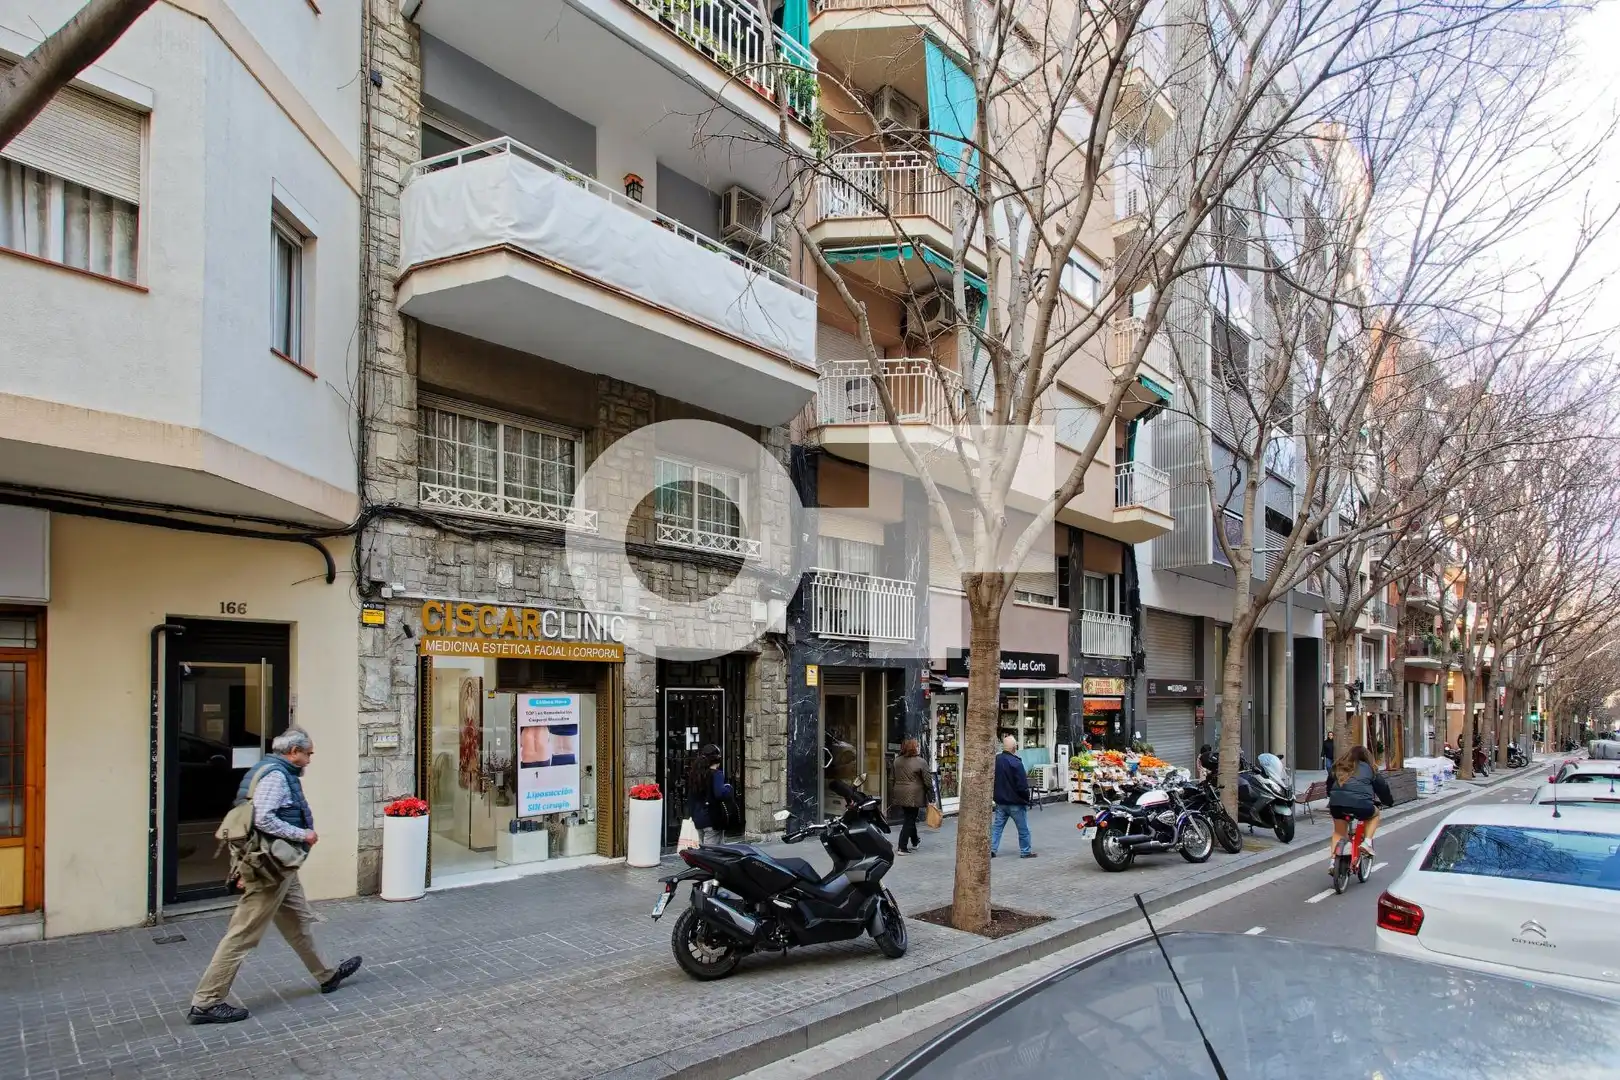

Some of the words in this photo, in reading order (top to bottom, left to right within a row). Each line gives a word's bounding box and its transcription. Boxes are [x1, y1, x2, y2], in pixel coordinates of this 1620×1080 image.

[219, 601, 247, 615] 166
[425, 640, 480, 653] MEDICINA
[482, 641, 531, 655] ESTÈTICA
[534, 645, 566, 657] FACIAL
[573, 647, 620, 659] CORPORAL
[1018, 660, 1028, 671] Les
[1029, 660, 1046, 672] Corts
